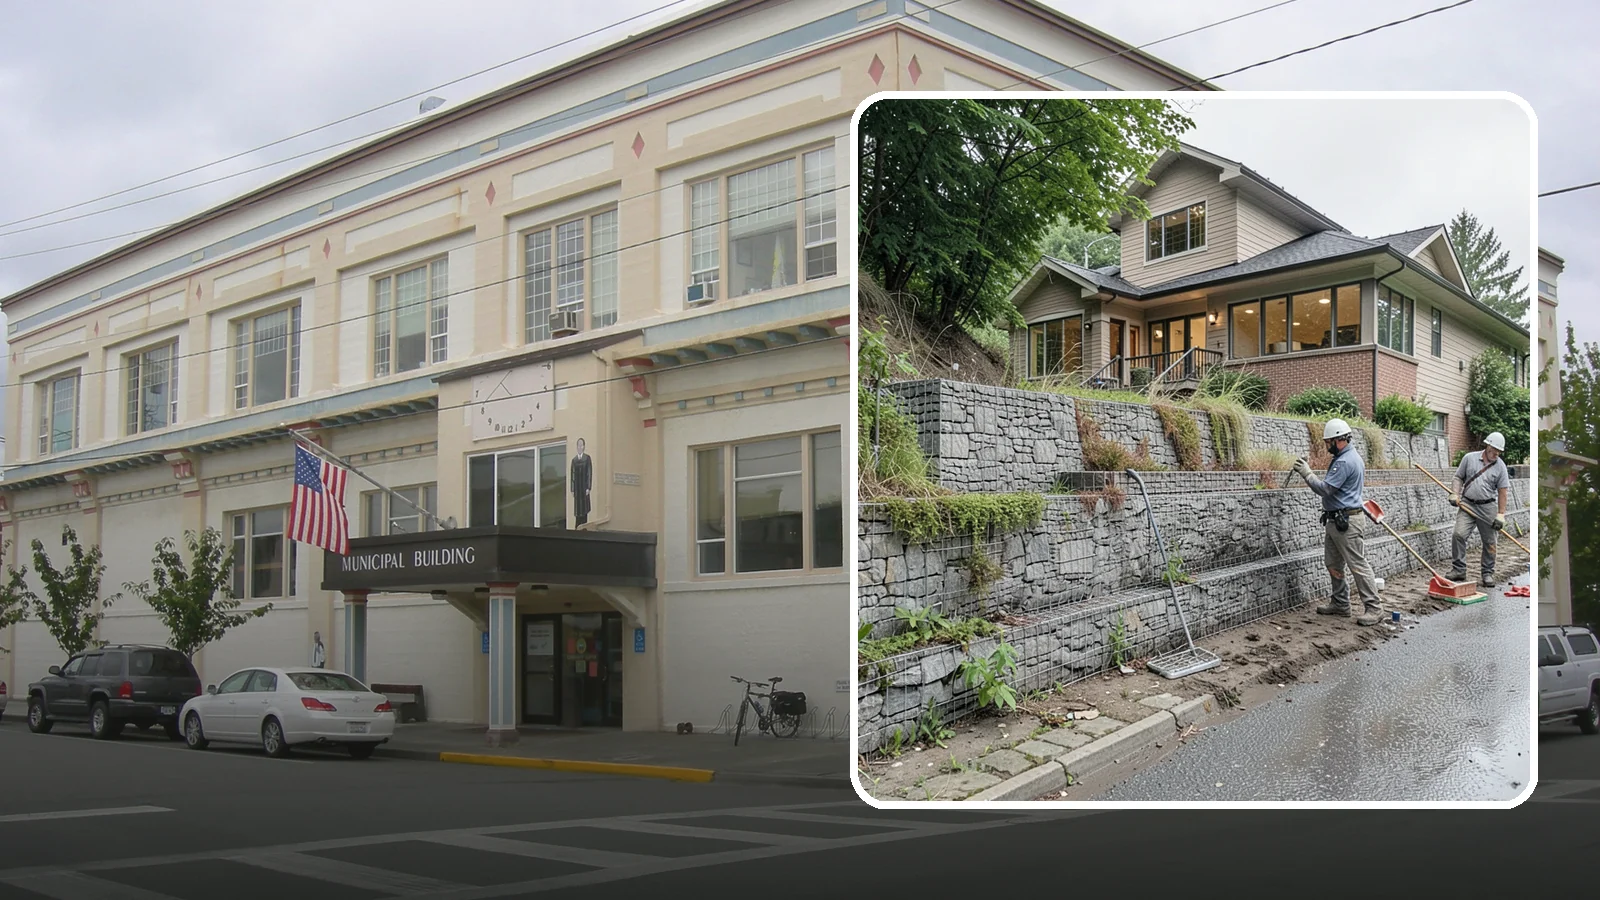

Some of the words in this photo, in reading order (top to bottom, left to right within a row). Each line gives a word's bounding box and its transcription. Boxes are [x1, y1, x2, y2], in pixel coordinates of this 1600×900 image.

[475, 390, 479, 398] 7
[480, 407, 485, 415] 8
[508, 425, 513, 433] 12
[521, 420, 525, 428] 2
[529, 414, 533, 422] 3
[536, 402, 540, 410] 4
[342, 552, 405, 572] MUNICIPAL
[414, 546, 475, 567] BUILDING
